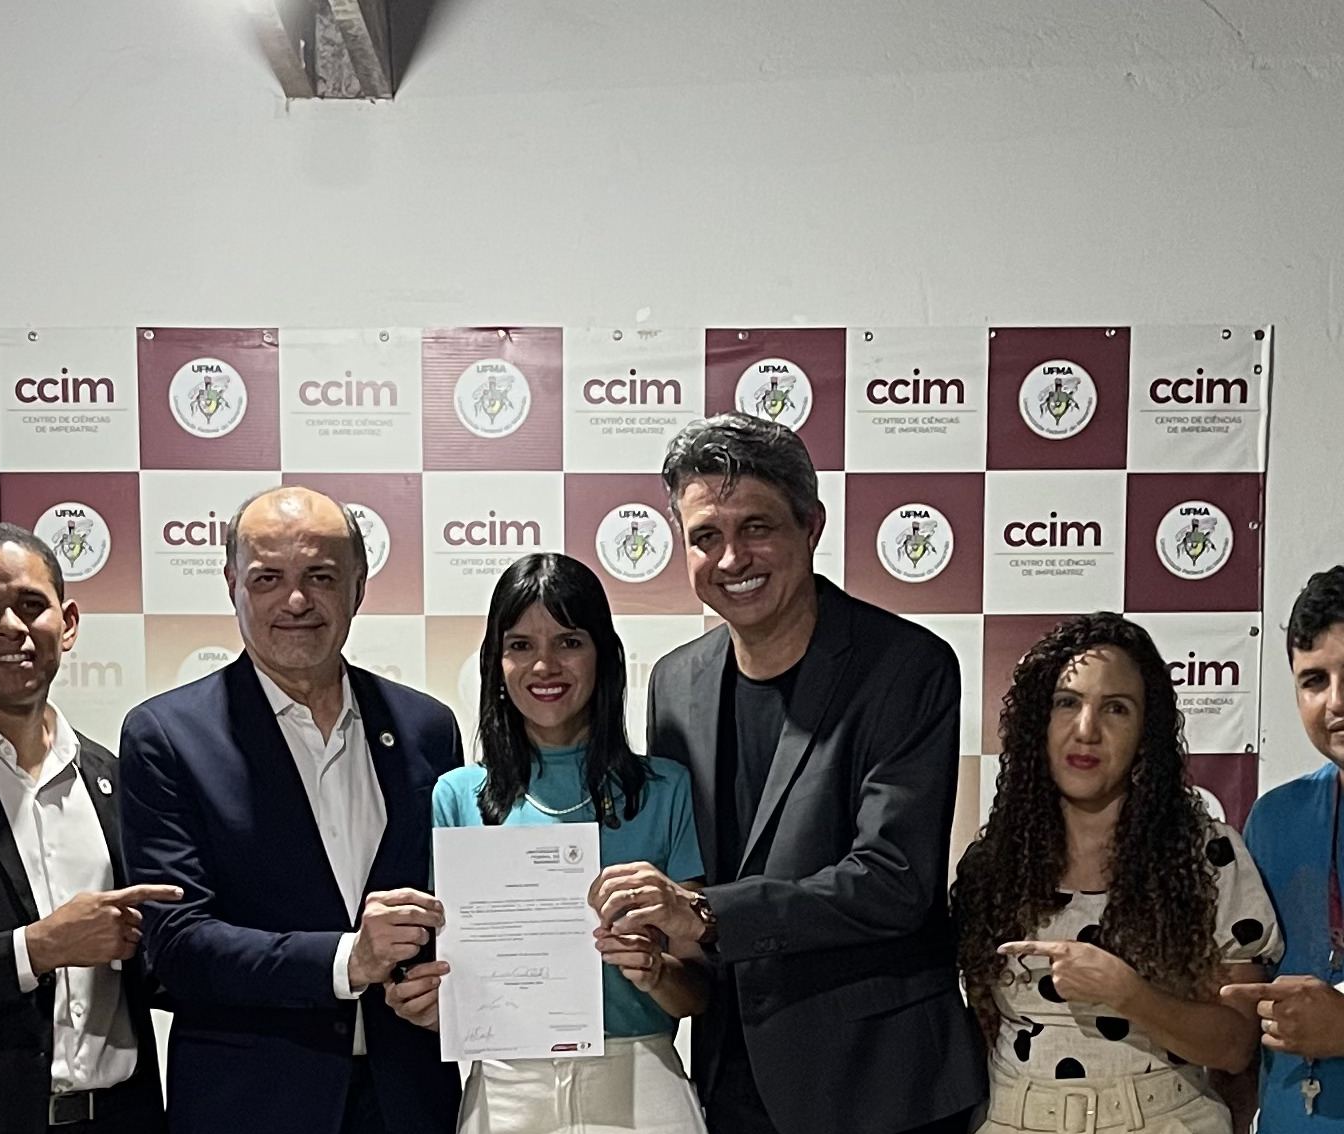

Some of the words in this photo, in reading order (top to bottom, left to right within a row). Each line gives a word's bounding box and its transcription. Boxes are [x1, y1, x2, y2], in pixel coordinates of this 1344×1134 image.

[191, 364, 223, 374] UFMA
[758, 365, 789, 374] UFMA
[1042, 366, 1074, 376] UFMA
[15, 367, 114, 403] ccim
[298, 370, 398, 407] ccim
[583, 368, 682, 405] ccim
[866, 368, 965, 405] ccim
[1149, 368, 1248, 404] ccim
[55, 509, 85, 518] UFMA
[618, 510, 649, 519] UFMA
[899, 510, 930, 519] UFMA
[1179, 507, 1210, 516] UFMA
[443, 510, 541, 546] ccim
[1004, 511, 1102, 547] ccim
